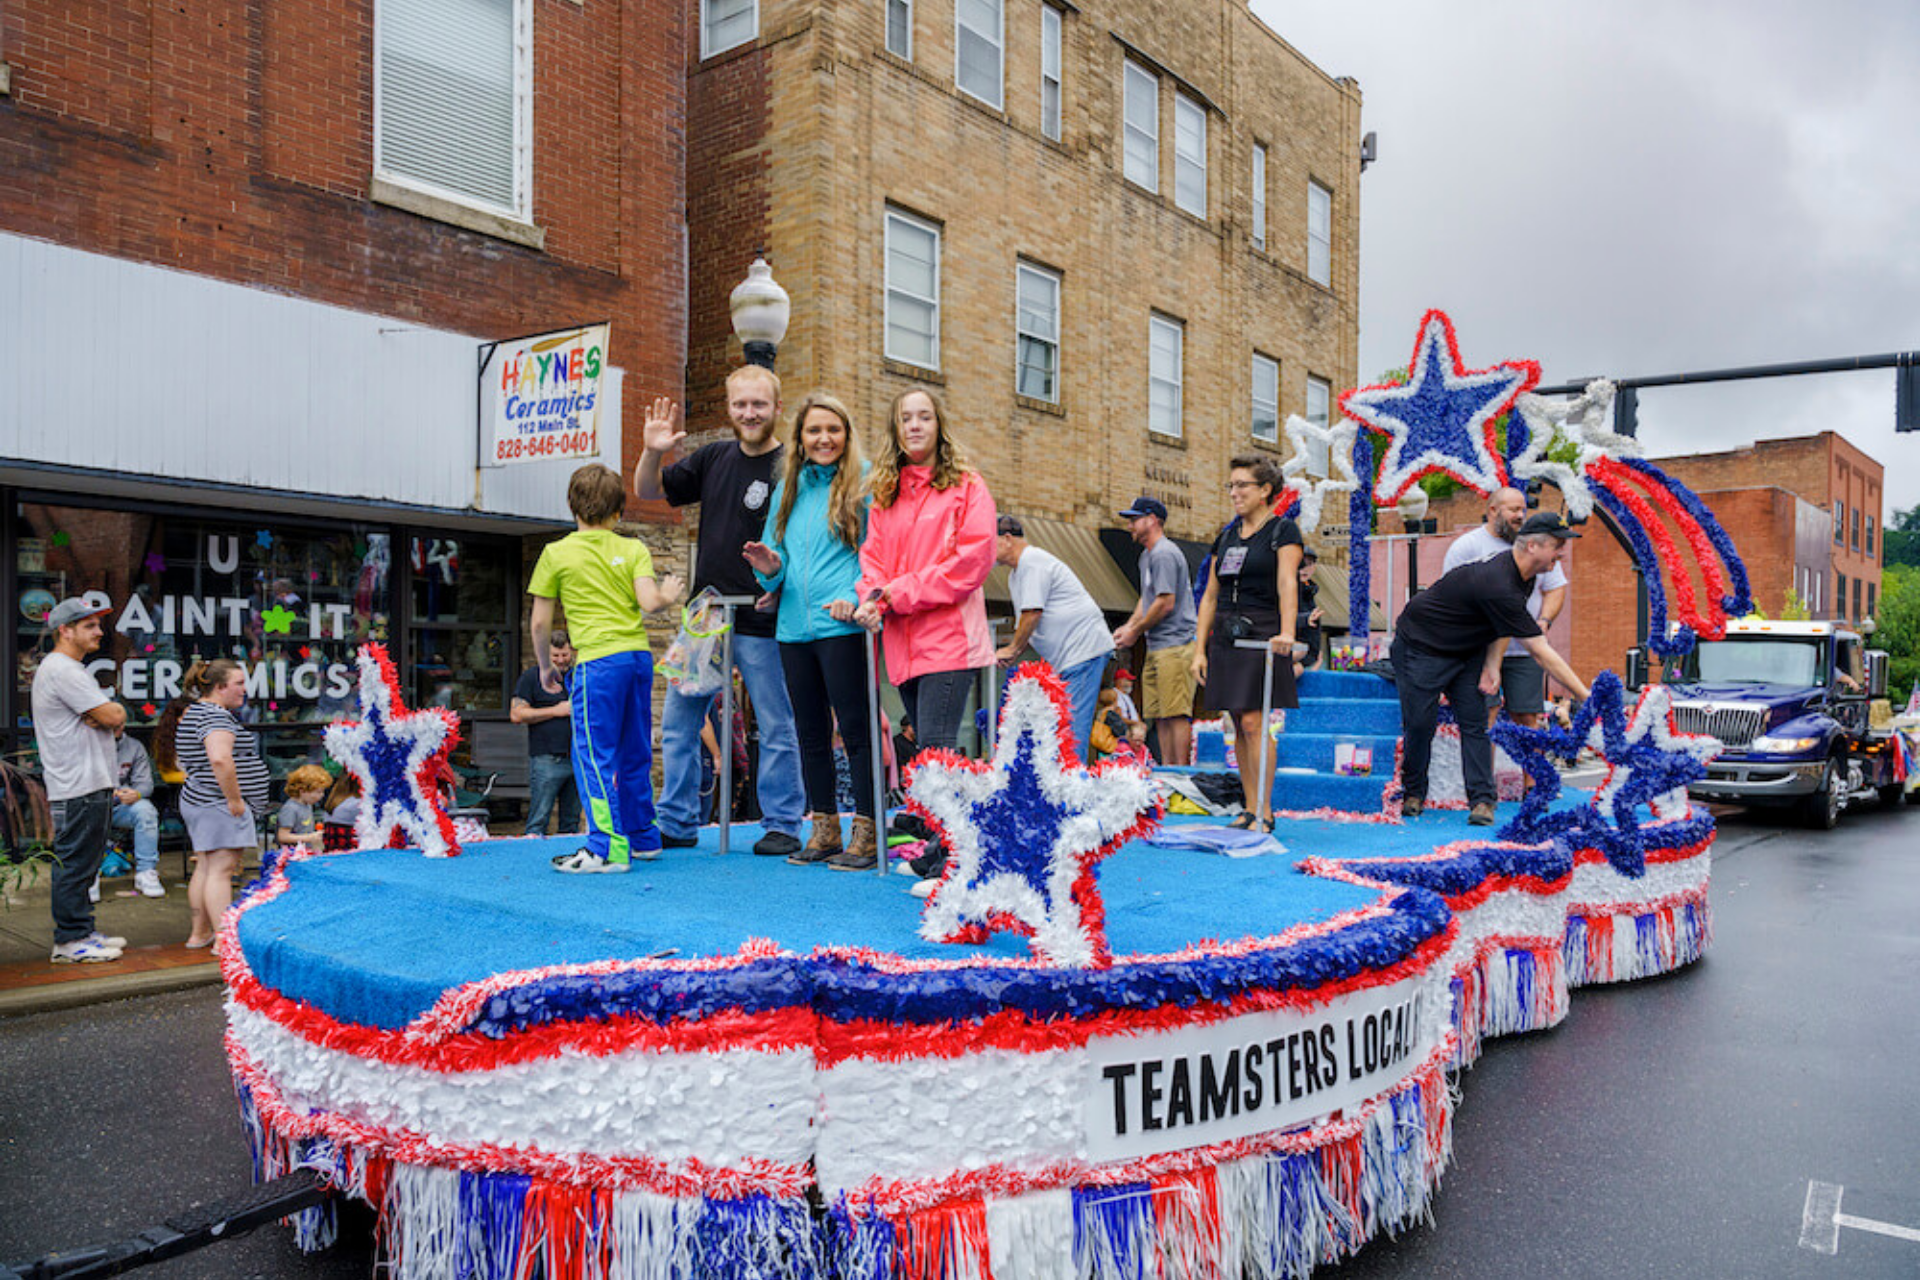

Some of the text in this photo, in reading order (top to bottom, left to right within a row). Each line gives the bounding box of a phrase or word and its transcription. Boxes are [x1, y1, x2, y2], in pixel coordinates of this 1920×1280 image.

[502, 346, 601, 392] HAYNES
[505, 390, 596, 421] Ceramics
[497, 431, 597, 459] 828-646-0401
[518, 420, 535, 434] 112
[538, 418, 563, 433] Main
[208, 535, 239, 574] U
[309, 602, 351, 640] IT
[84, 658, 350, 699] CERMICS
[1103, 1023, 1338, 1135] TEAMSTERS
[1347, 1001, 1411, 1080] LOCAL
